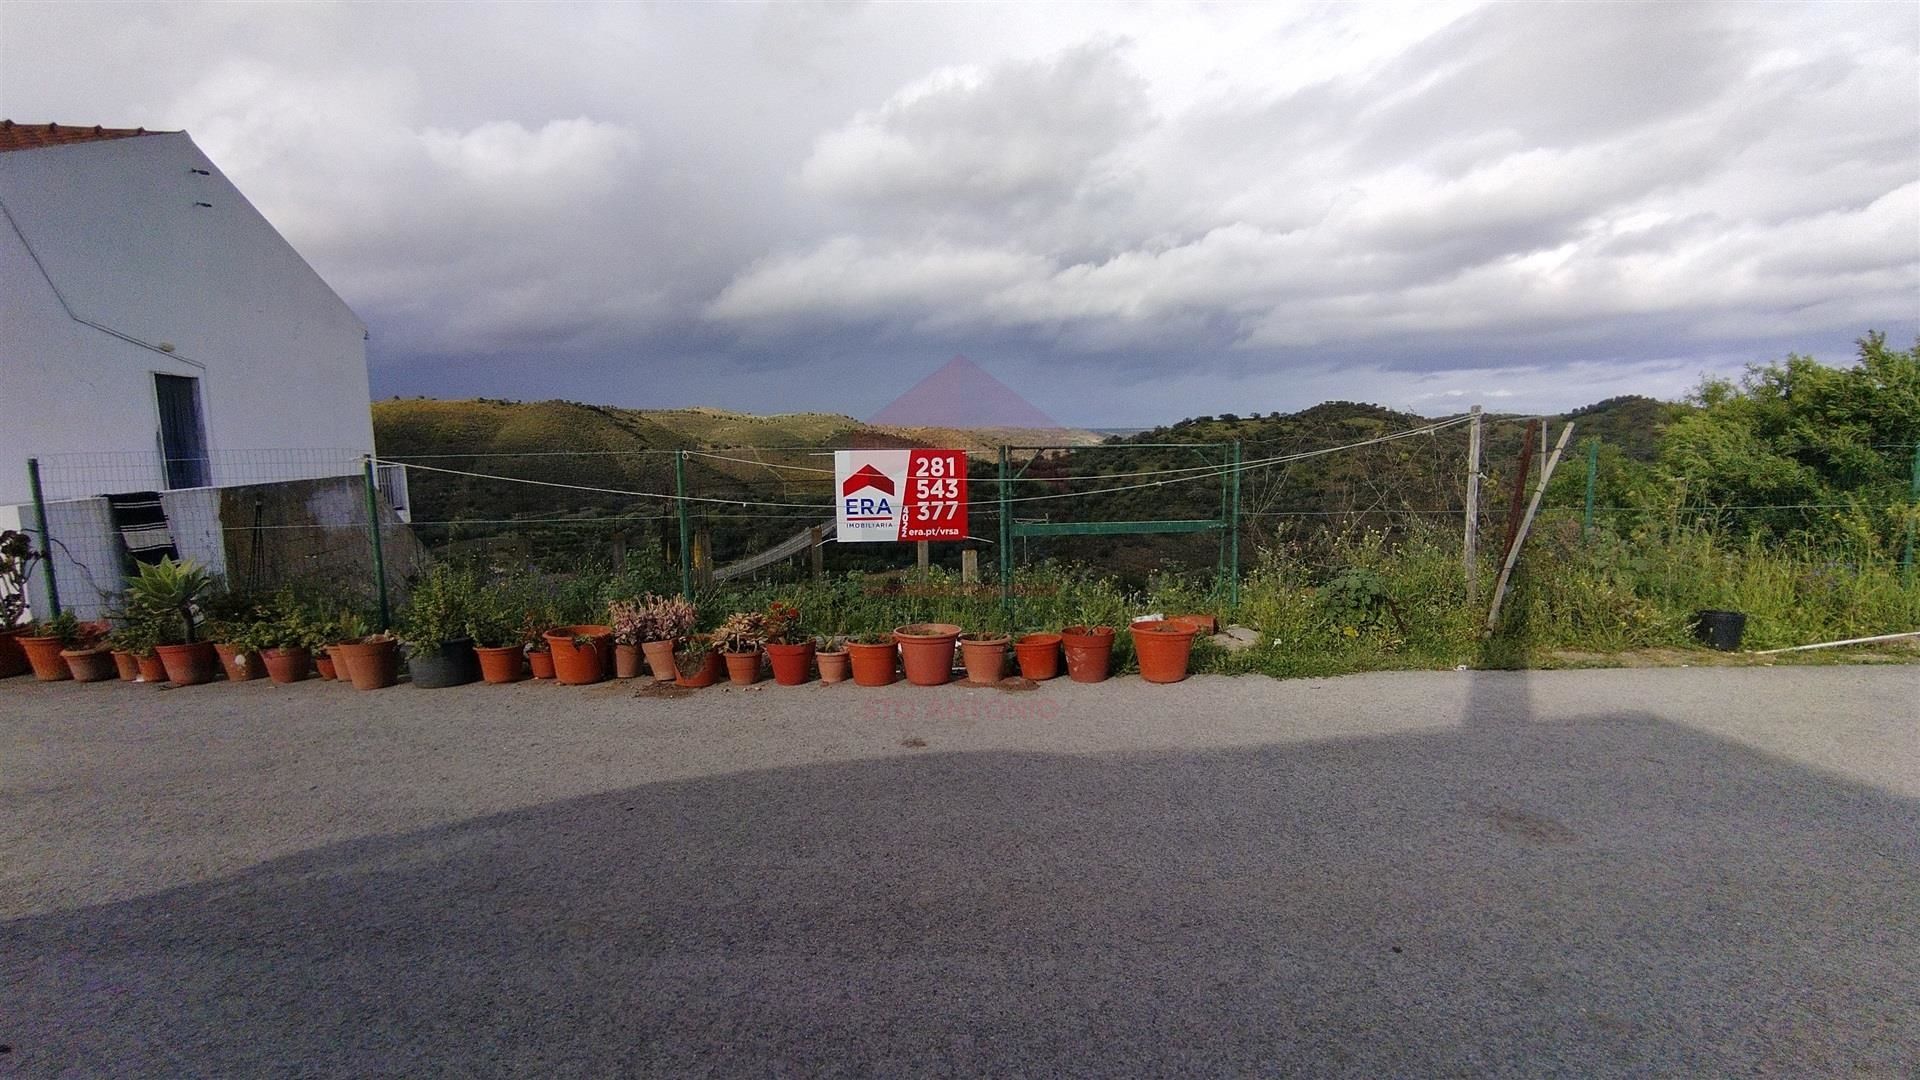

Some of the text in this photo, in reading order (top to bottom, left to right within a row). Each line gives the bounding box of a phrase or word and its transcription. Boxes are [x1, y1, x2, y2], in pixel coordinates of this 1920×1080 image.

[916, 457, 955, 477] 281
[916, 479, 958, 499] 543
[846, 498, 892, 515] ERA
[917, 501, 958, 520] 377
[909, 527, 959, 537] era.pt/vrsa
